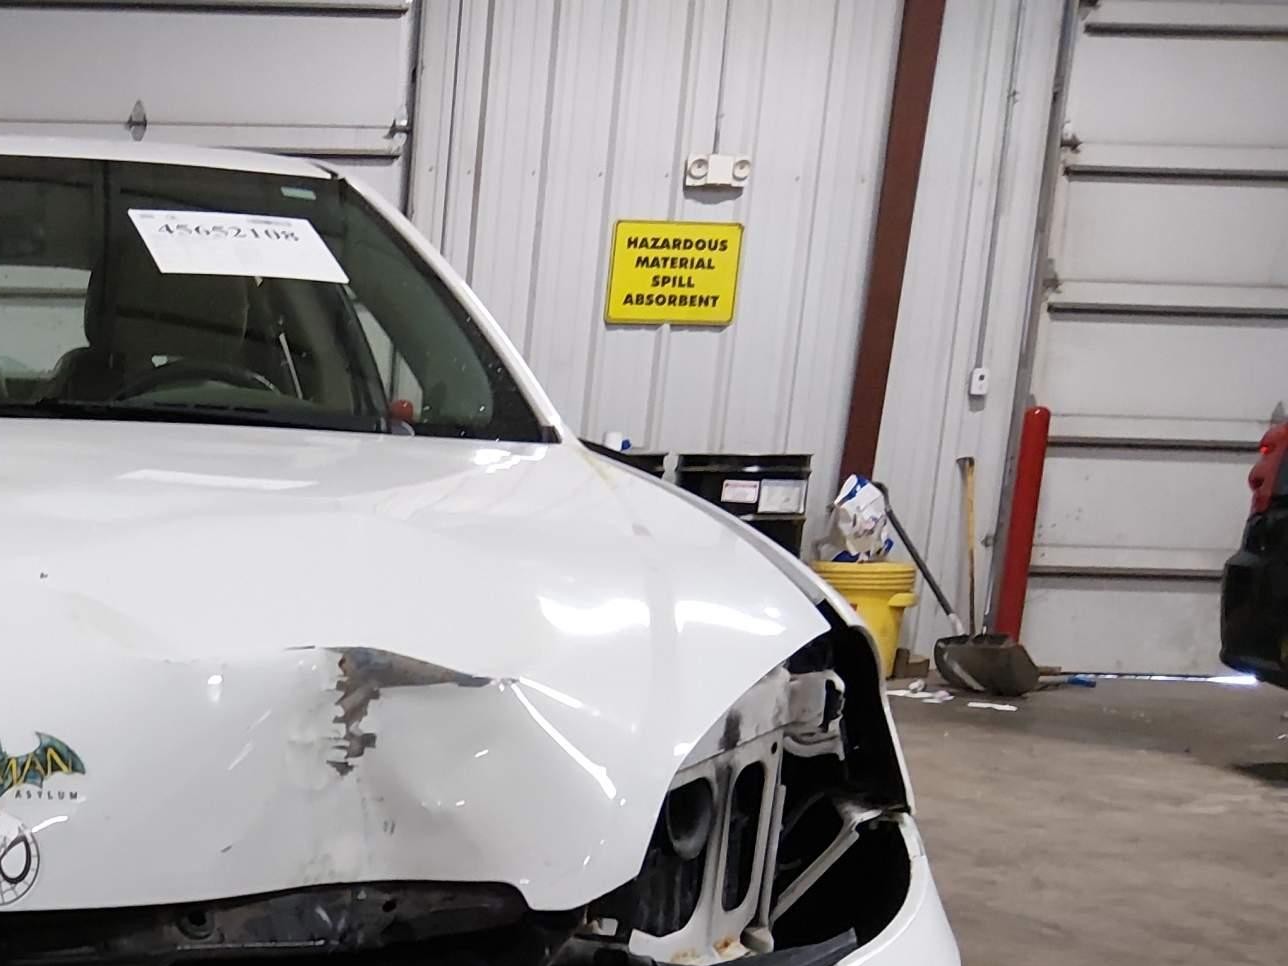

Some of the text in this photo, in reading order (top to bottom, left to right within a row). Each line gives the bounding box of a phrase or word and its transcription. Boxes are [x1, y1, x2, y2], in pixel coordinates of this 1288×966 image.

[158, 223, 299, 242] 45652108
[626, 236, 728, 252] HAZARDOUS
[635, 256, 715, 270] MATERIAL
[651, 275, 695, 288] SPILL
[623, 293, 719, 308] ABSORBENT
[14, 790, 79, 800] ASYLUM
